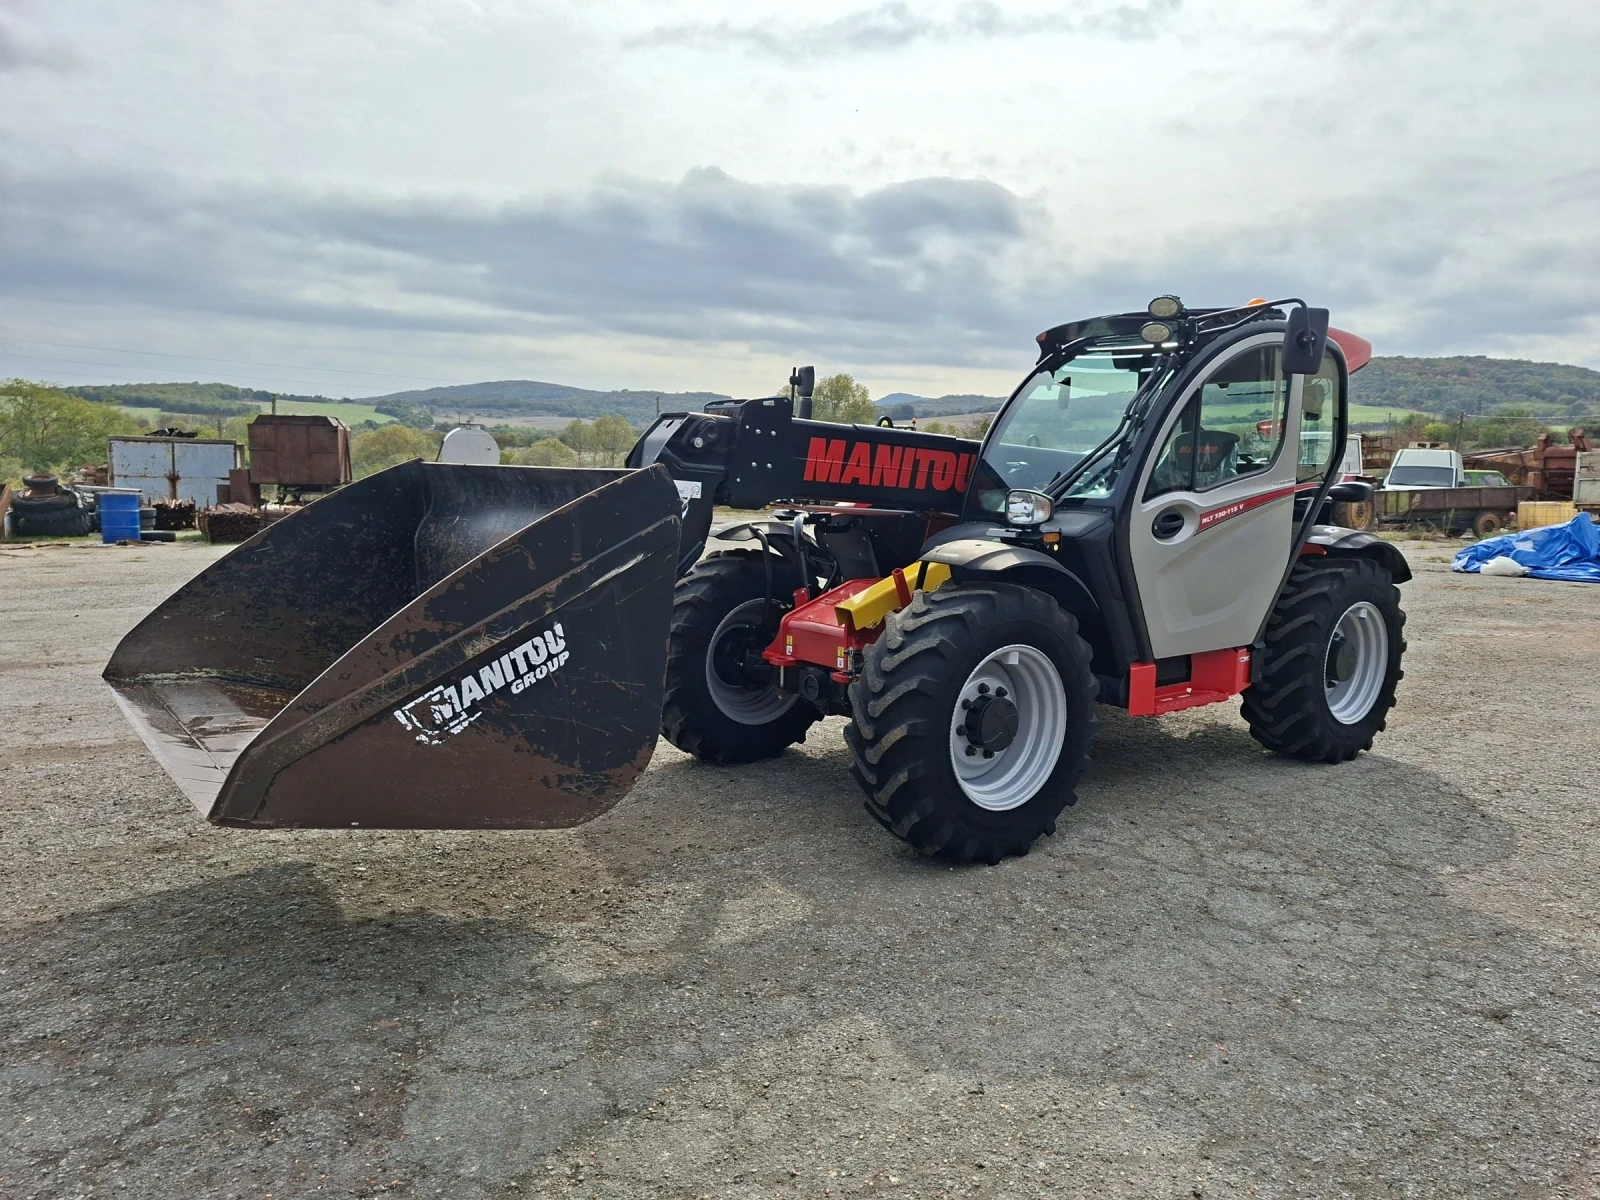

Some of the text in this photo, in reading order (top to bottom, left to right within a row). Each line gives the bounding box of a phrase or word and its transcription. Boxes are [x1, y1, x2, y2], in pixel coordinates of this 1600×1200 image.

[804, 437, 977, 493] MANITOU
[1202, 515, 1214, 524] MLT
[1214, 506, 1238, 519] 730-115
[510, 650, 570, 694] GROUP
